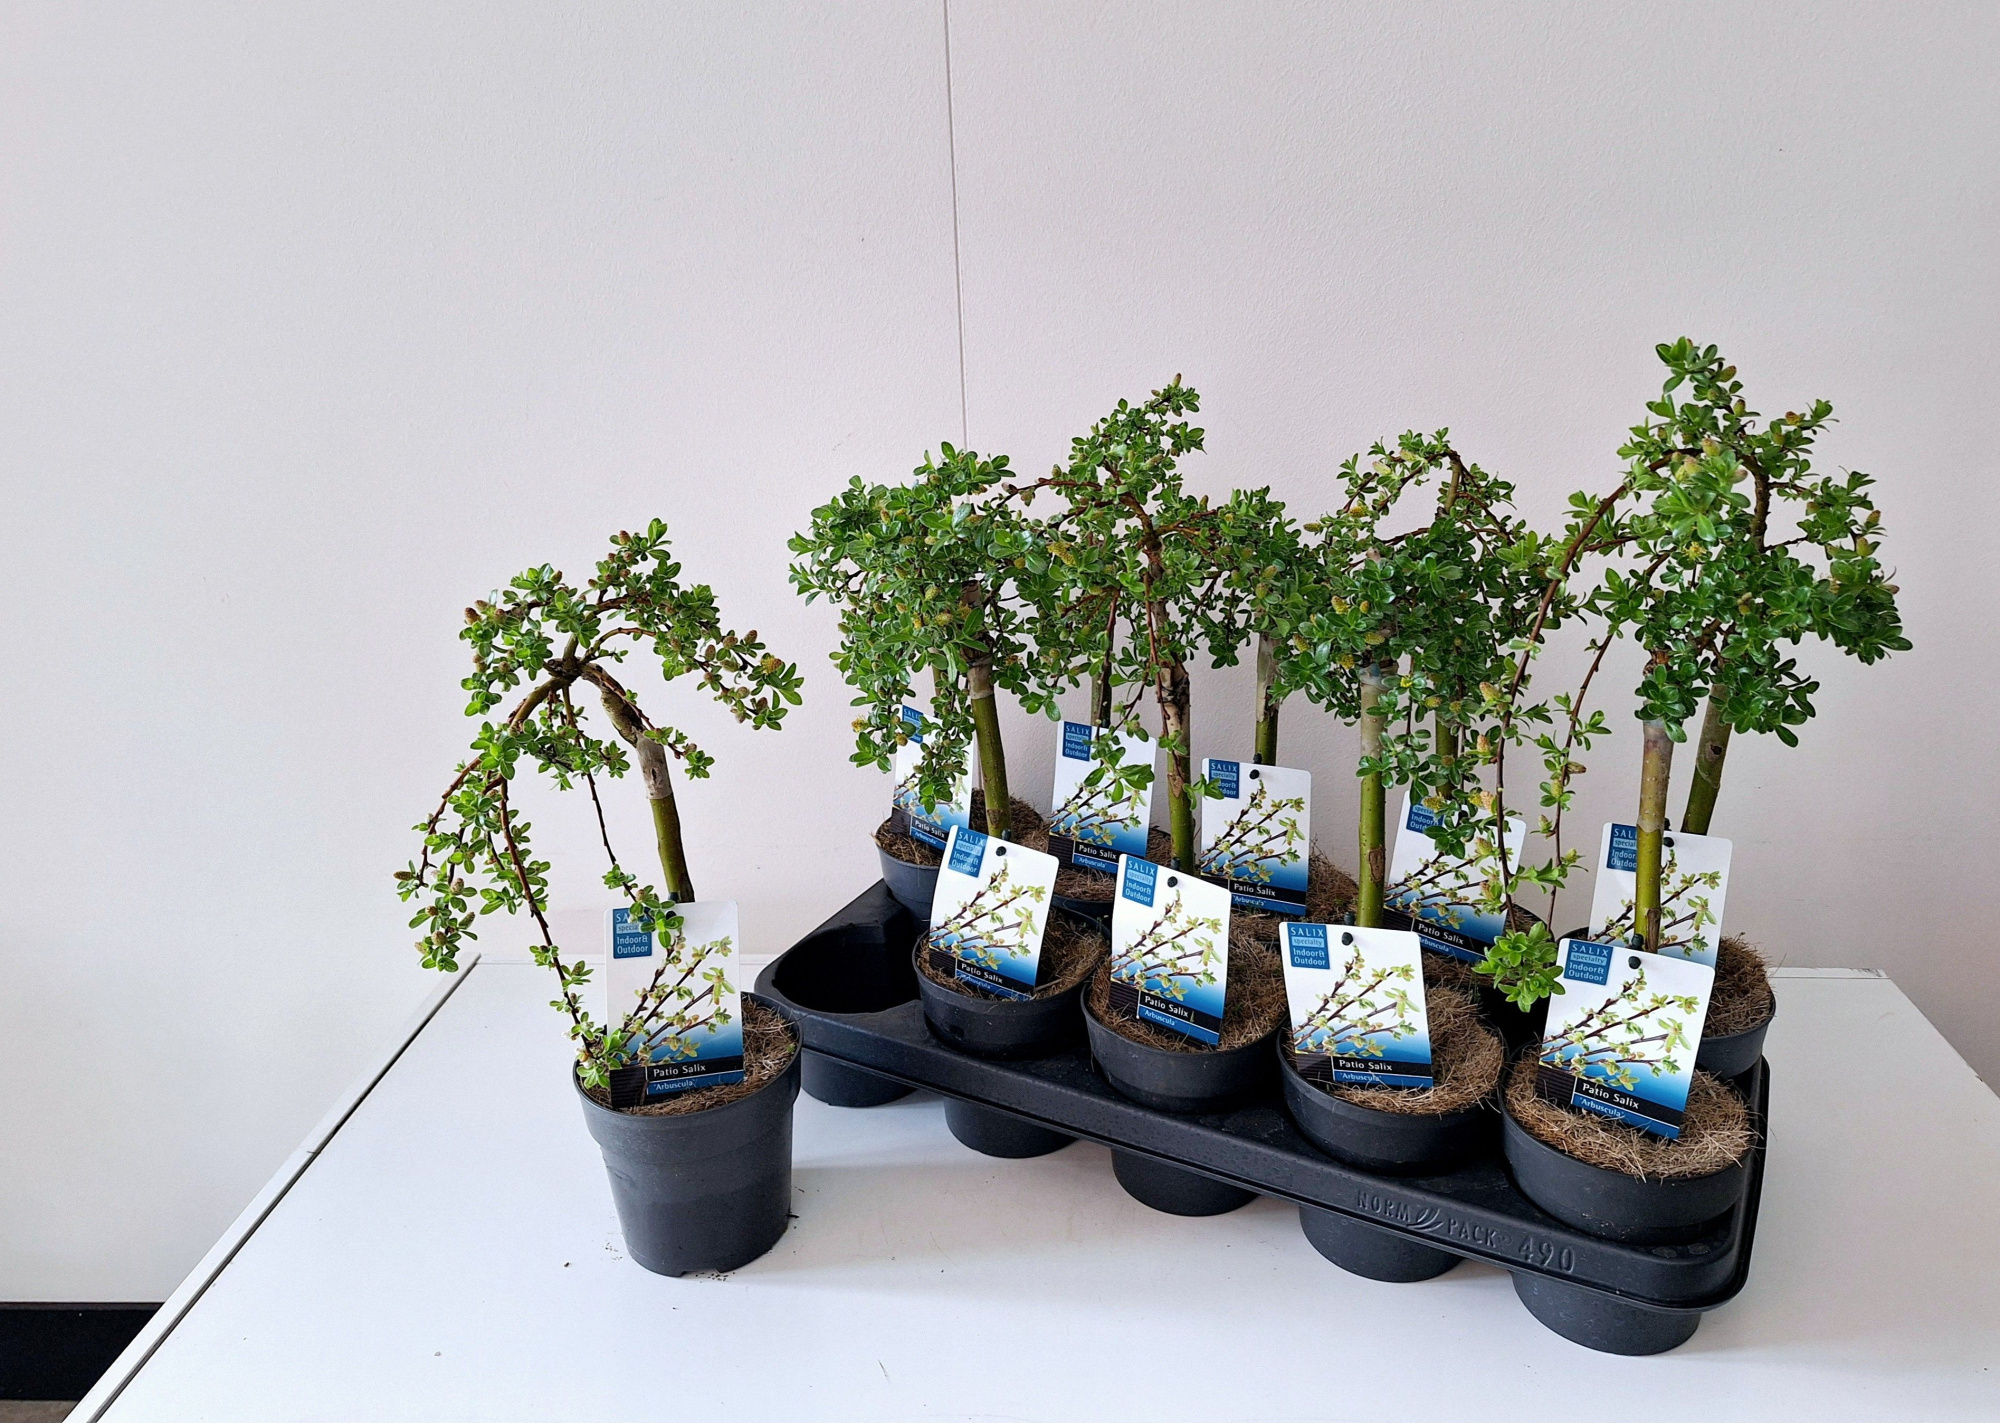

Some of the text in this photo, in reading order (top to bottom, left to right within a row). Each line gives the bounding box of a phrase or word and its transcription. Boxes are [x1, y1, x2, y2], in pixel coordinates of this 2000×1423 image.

[904, 709, 919, 719] SALI
[1065, 725, 1090, 736] SALIX
[1065, 748, 1088, 758] Outdoor
[1211, 763, 1238, 773] SALIX
[914, 820, 946, 838] Patio Salix
[958, 831, 986, 847] SALIX
[1614, 840, 1636, 848] special
[1079, 844, 1117, 860] Patio Salix
[1611, 849, 1636, 860] Indoor
[951, 859, 978, 873] Outdoor
[1128, 860, 1155, 876] SALIX
[1610, 858, 1637, 869] Outdoo
[1125, 888, 1151, 903] Outdoor
[1234, 883, 1276, 897] Patio Salix
[1290, 927, 1324, 937] SALIX
[1418, 923, 1464, 945] Patio Salix
[1293, 938, 1323, 946] specialty
[617, 945, 649, 954] Outdoor
[1571, 944, 1609, 957] SALIX
[1294, 956, 1326, 966] Outdoor
[1572, 954, 1606, 964] specialty
[961, 963, 1003, 984] Patio Salix
[1568, 970, 1604, 981] Outdoor
[1144, 995, 1189, 1018] Patio Salix
[653, 1063, 706, 1078] Patio Salix
[1339, 1059, 1393, 1071] Patio Salix
[1582, 1083, 1639, 1109] Patio Salix
[1356, 1191, 1411, 1222] NORM
[1518, 1235, 1576, 1274] 490
